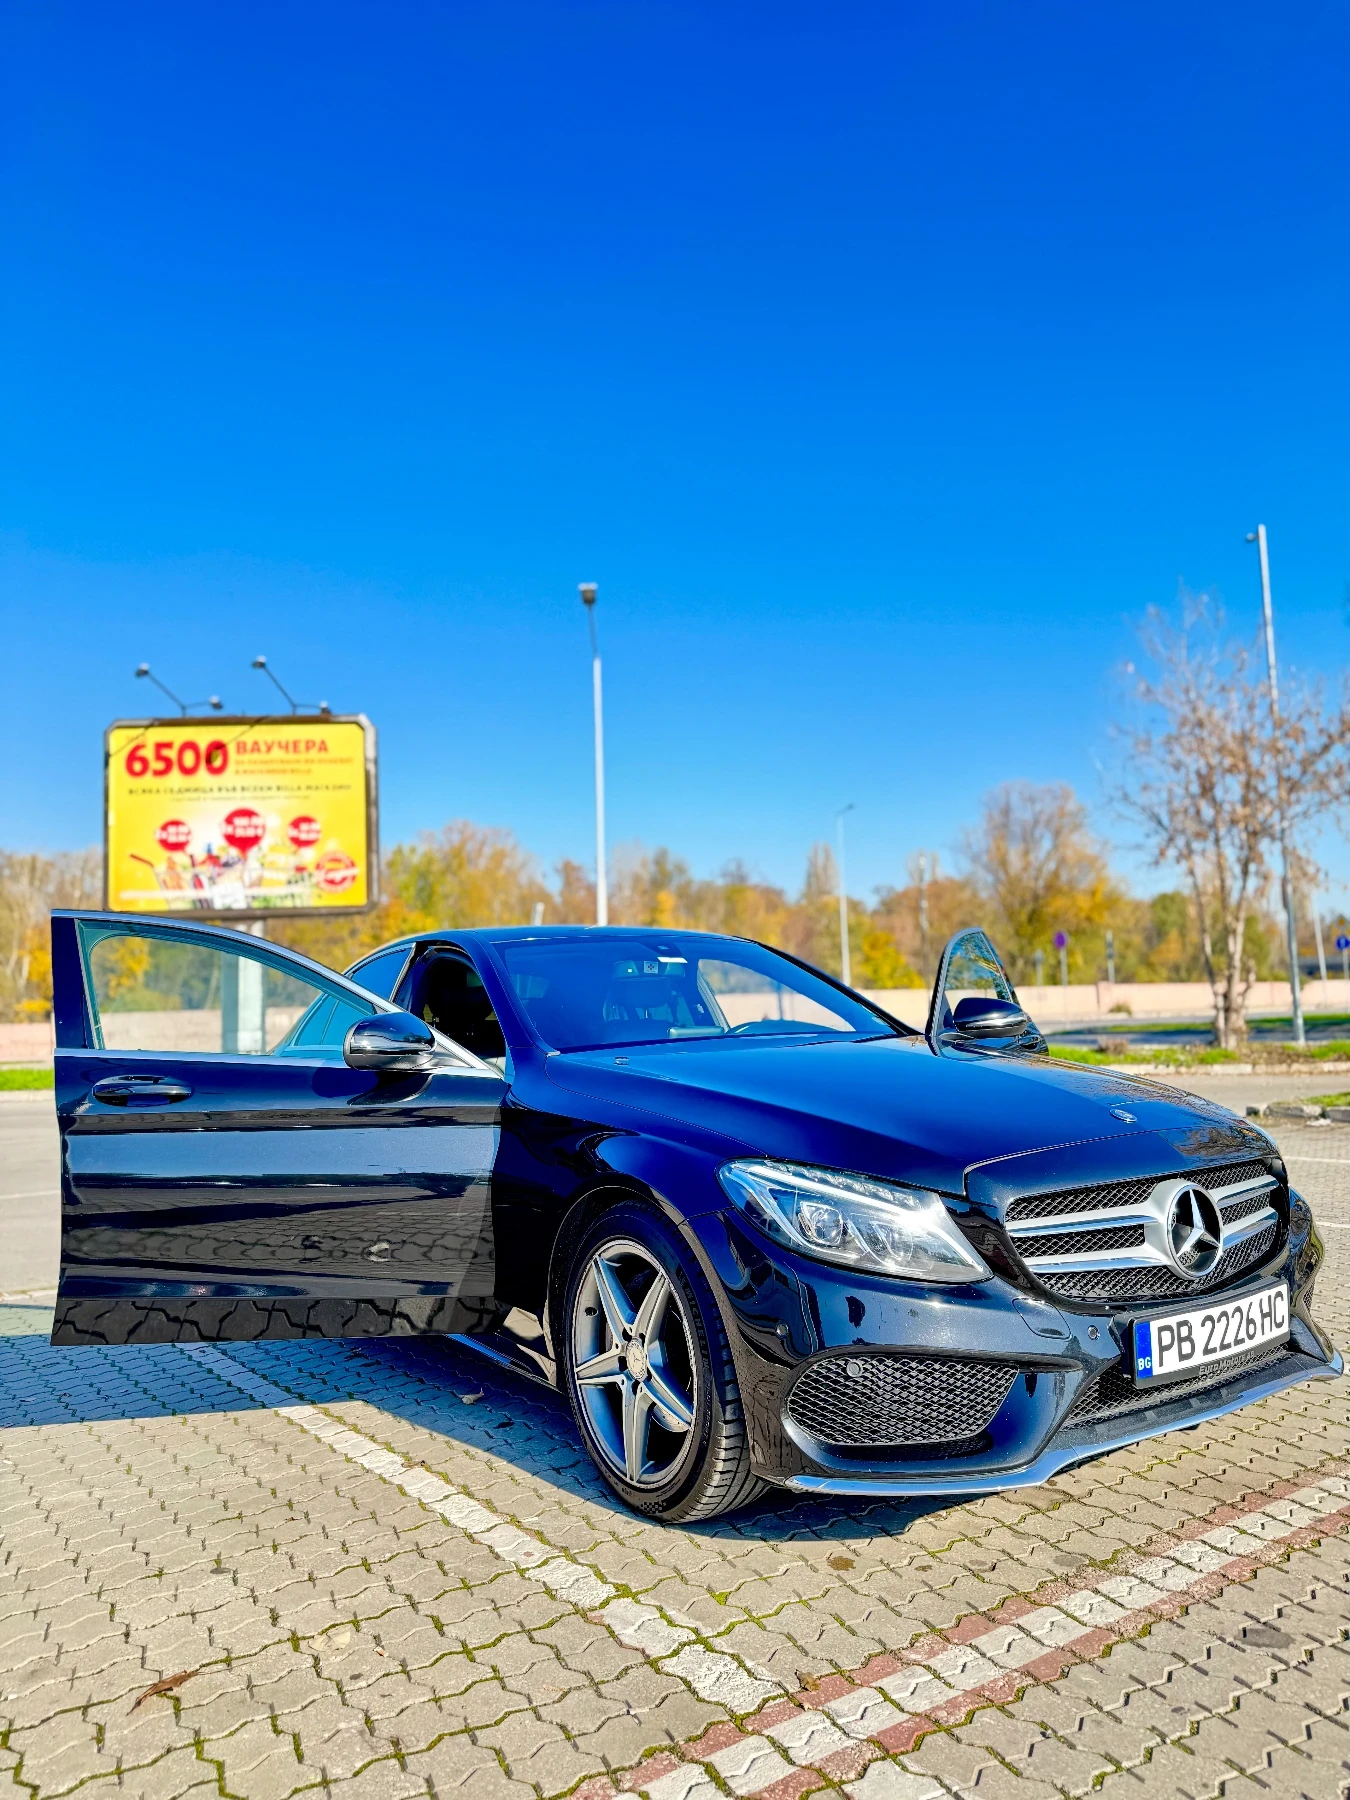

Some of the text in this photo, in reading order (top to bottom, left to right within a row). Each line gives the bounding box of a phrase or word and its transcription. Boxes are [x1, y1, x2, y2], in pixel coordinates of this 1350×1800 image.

[125, 739, 230, 778] 6500
[235, 739, 329, 756] ВАУЧЕРА
[684, 1287, 710, 1370] MICHELIN
[1157, 1290, 1285, 1368] PB 2226 HC
[1138, 1356, 1152, 1371] BG
